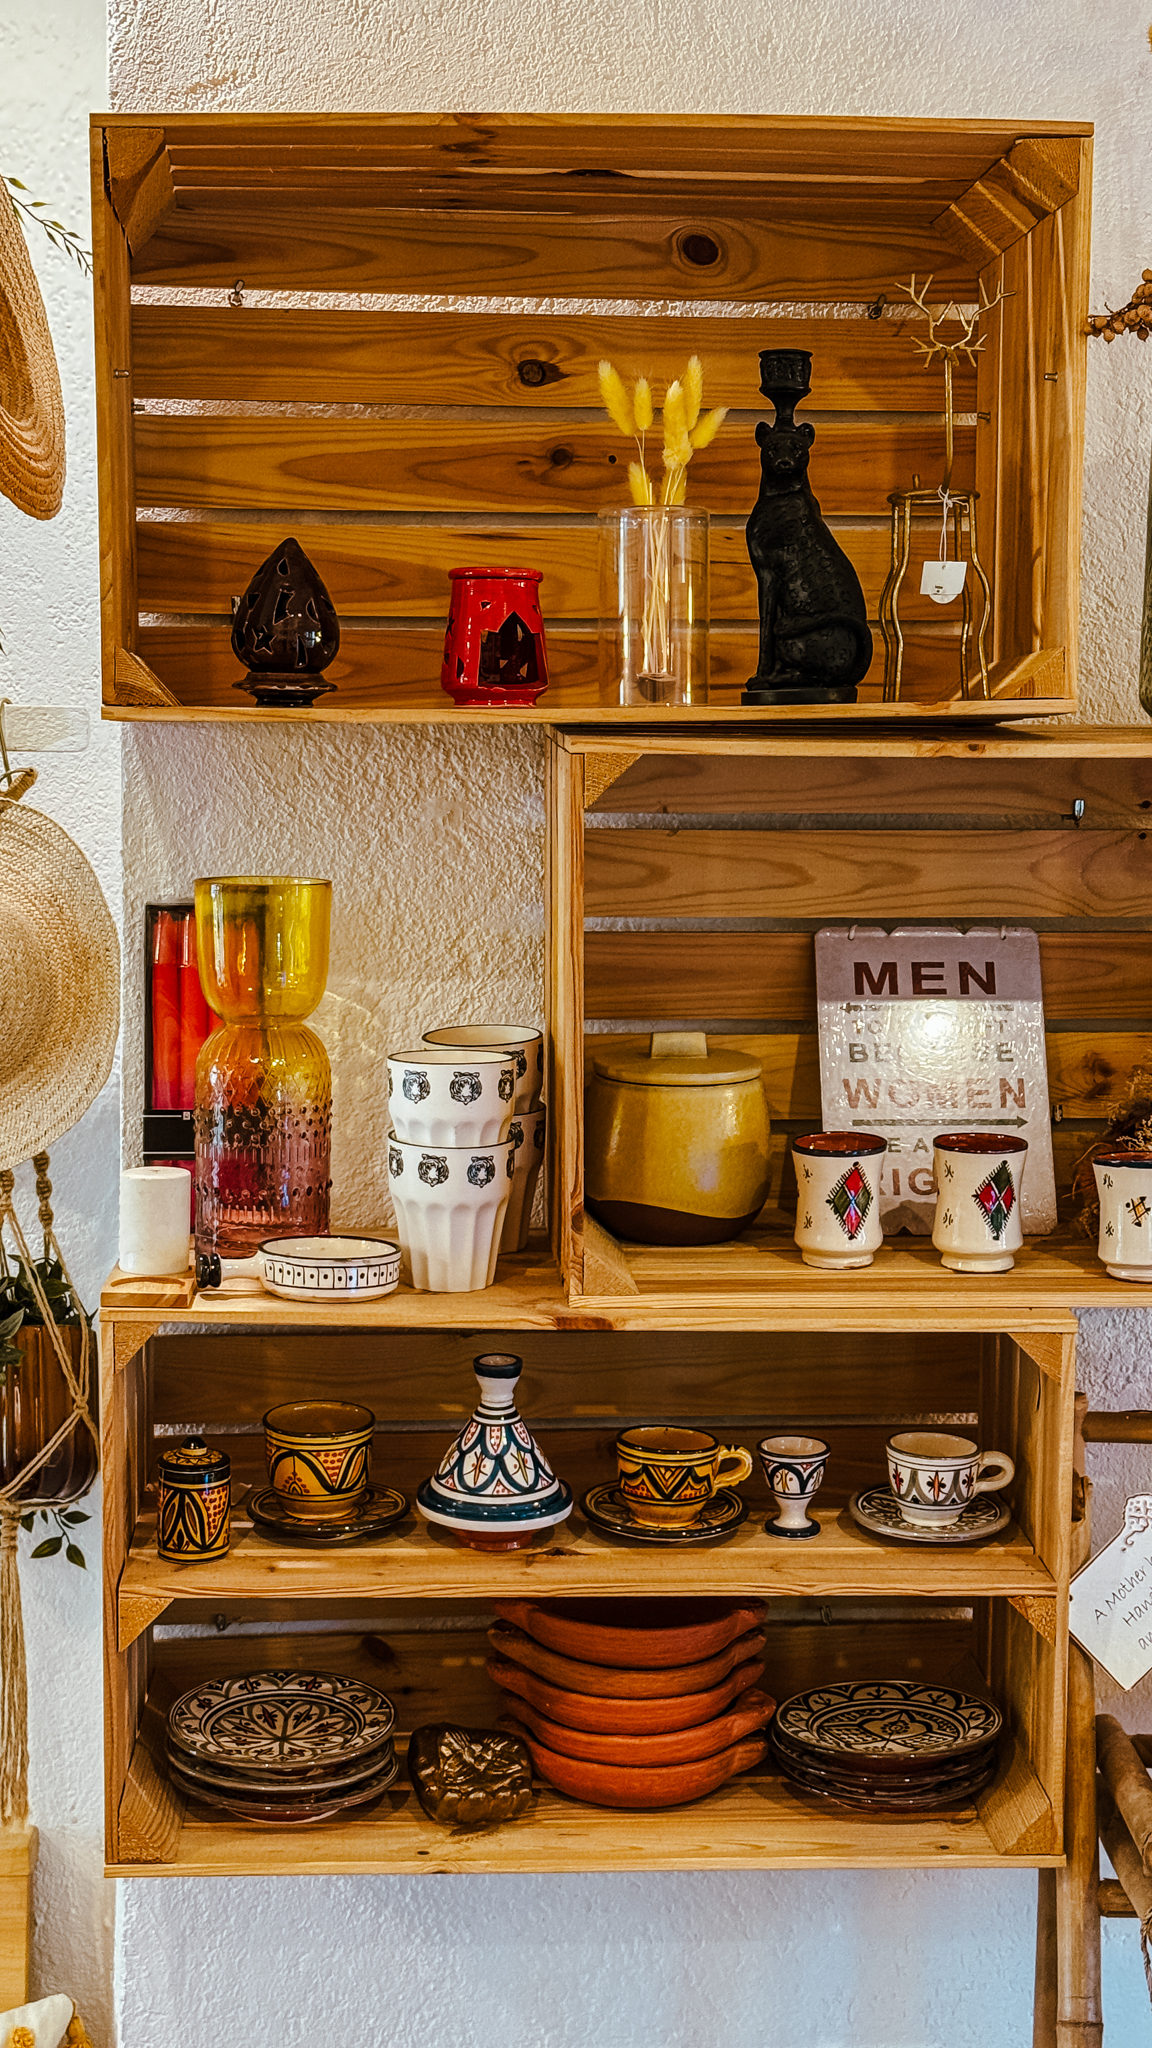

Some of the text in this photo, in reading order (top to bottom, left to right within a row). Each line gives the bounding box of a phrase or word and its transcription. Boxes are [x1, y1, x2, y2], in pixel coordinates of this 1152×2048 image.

[853, 962, 997, 996] MEN
[851, 1018, 883, 1035] TO
[842, 1077, 1027, 1110] WOMEN
[1094, 1565, 1147, 1625] A Mother
[1138, 1631, 1152, 1650] an
